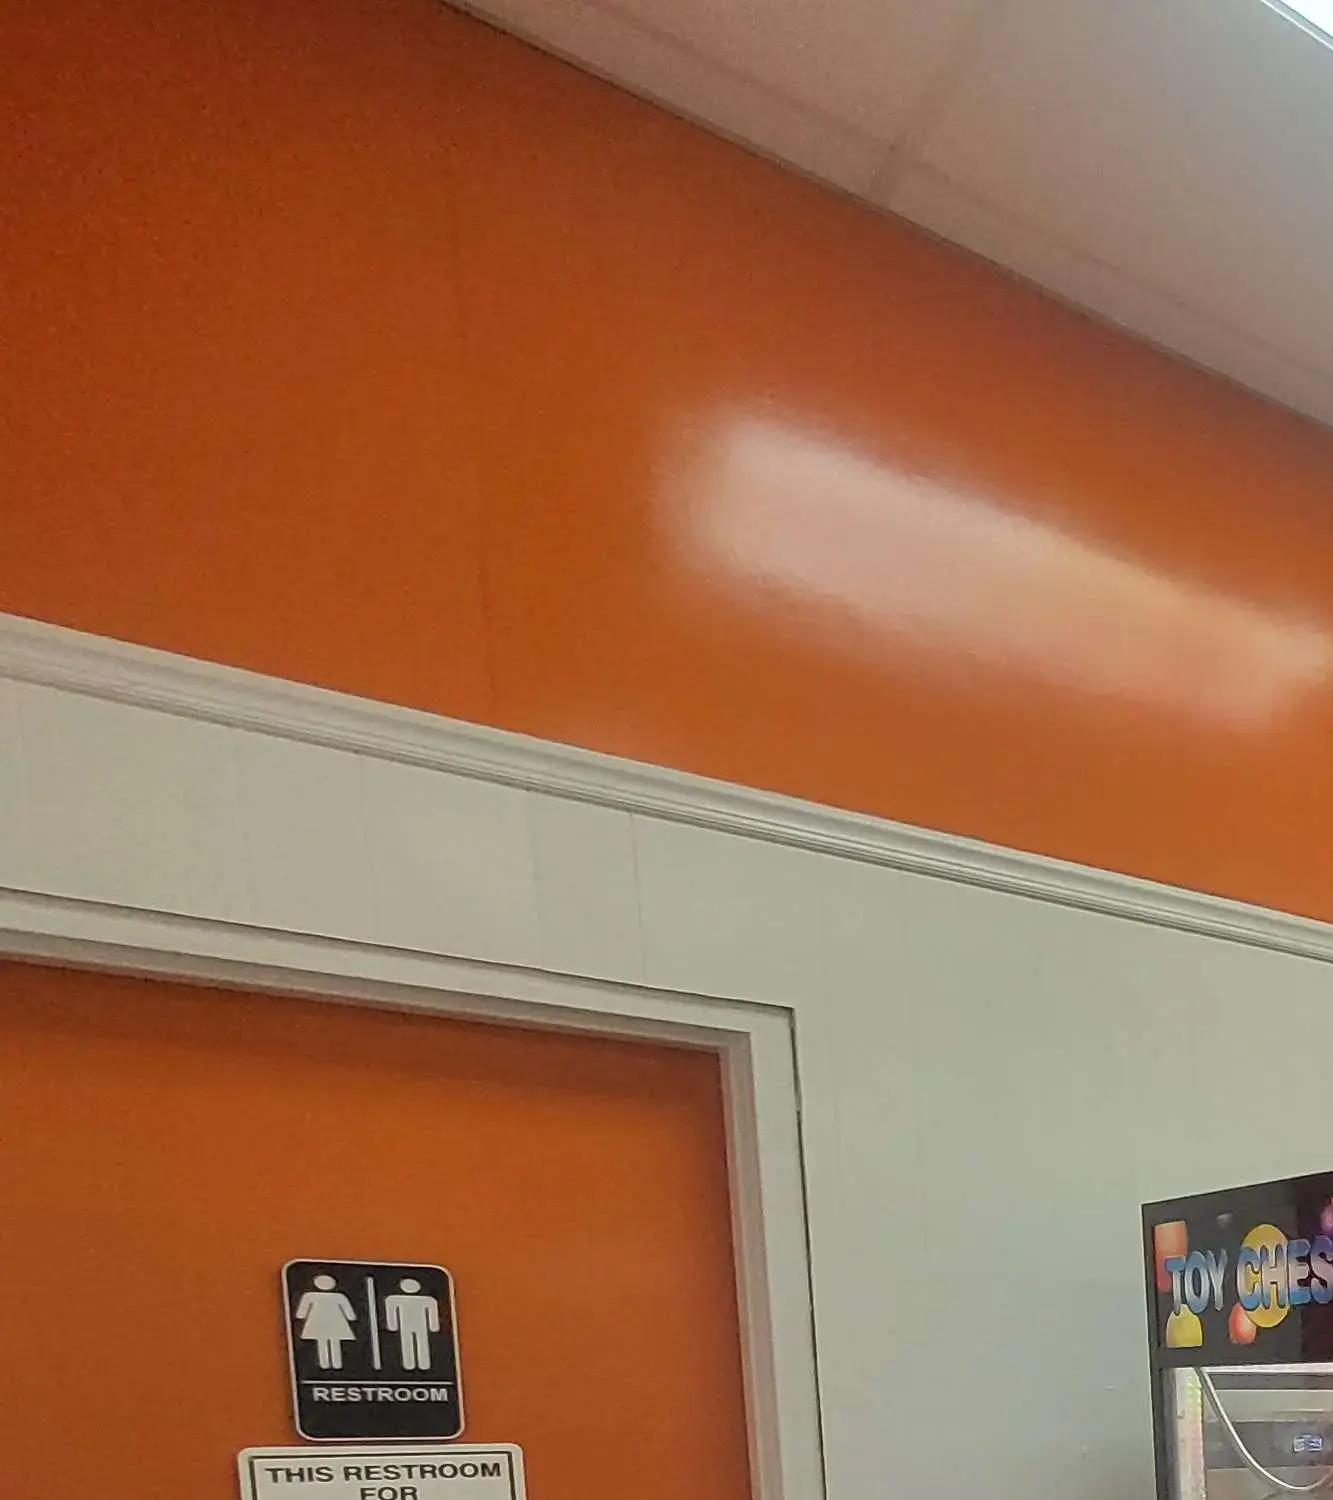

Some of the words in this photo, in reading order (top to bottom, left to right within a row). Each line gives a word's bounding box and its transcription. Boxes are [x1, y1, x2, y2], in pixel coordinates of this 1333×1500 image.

[1164, 1248, 1227, 1315] TOY
[312, 1386, 448, 1403] RESTROOM
[264, 1466, 334, 1483] THIS
[343, 1462, 502, 1482] RESTROOM
